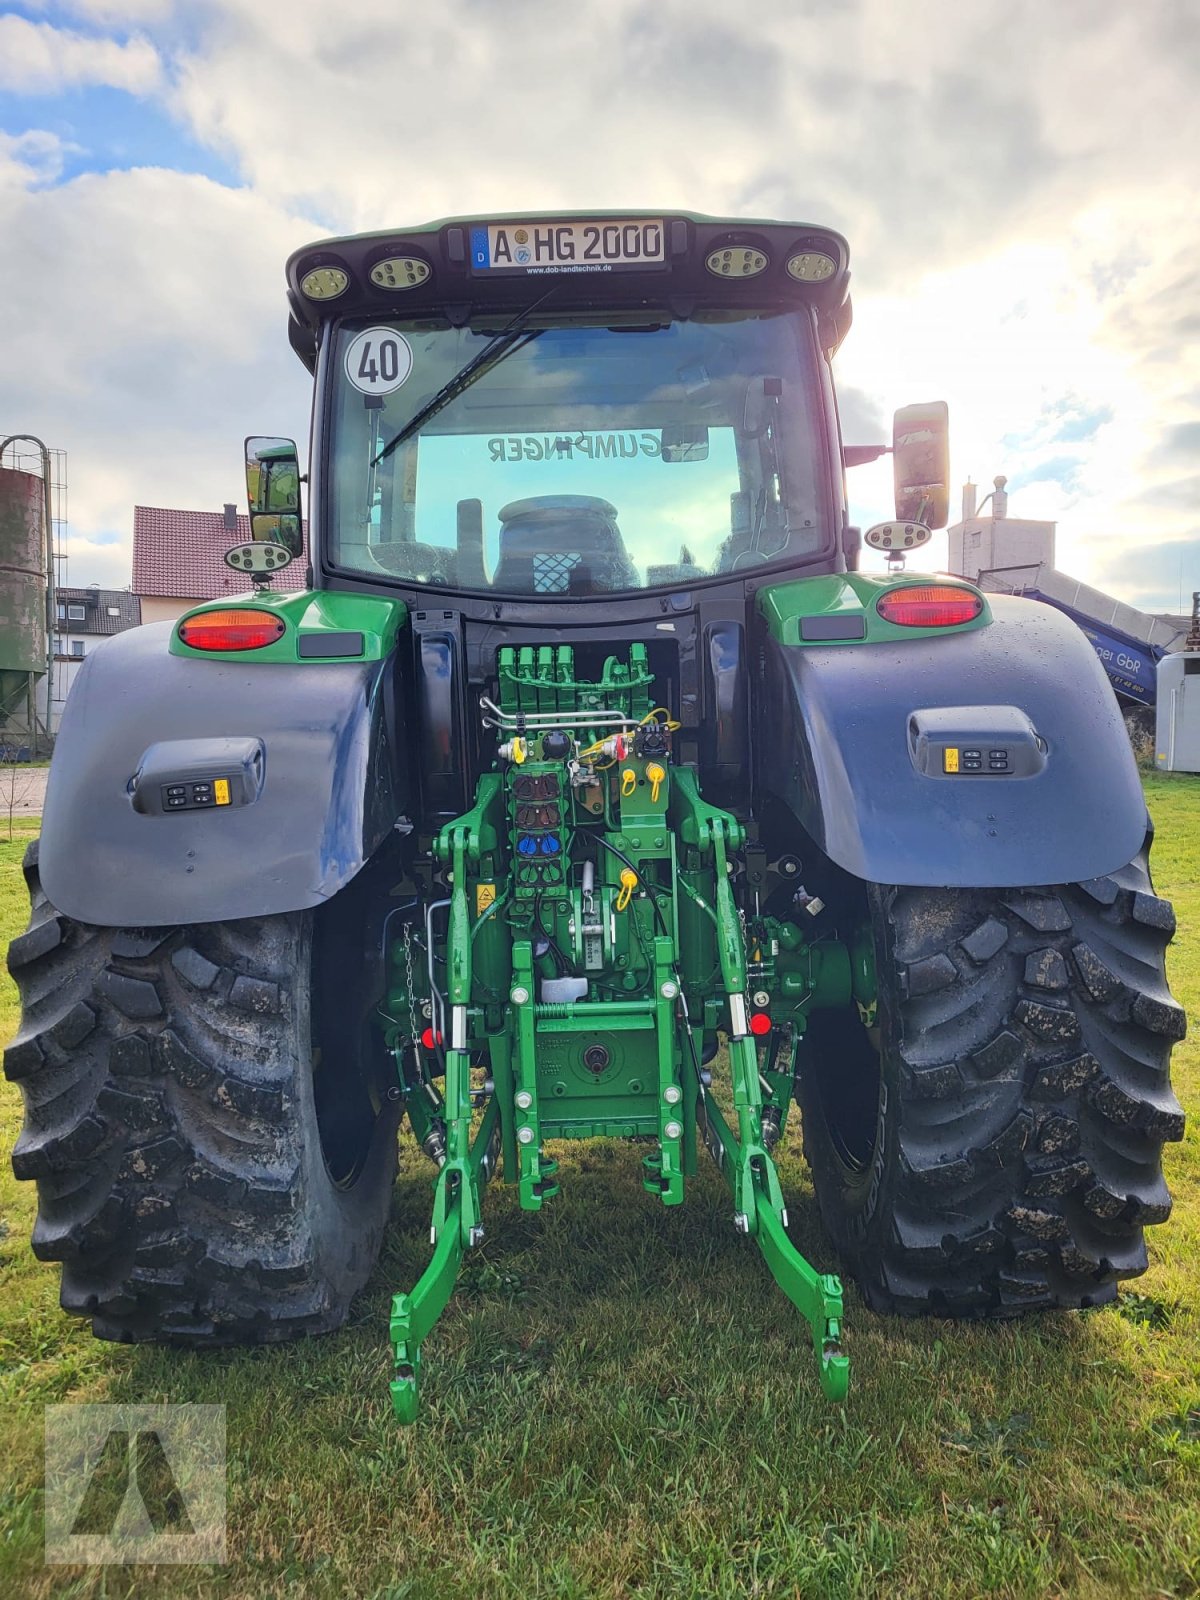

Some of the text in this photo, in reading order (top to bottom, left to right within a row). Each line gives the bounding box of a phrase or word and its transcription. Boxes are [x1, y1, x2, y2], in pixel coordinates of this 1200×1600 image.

[494, 224, 661, 263] A HG 2000
[477, 252, 485, 262] D
[526, 264, 612, 274] www.dob-landtechnik.de
[358, 339, 399, 383] 40
[1116, 653, 1141, 673] GbR
